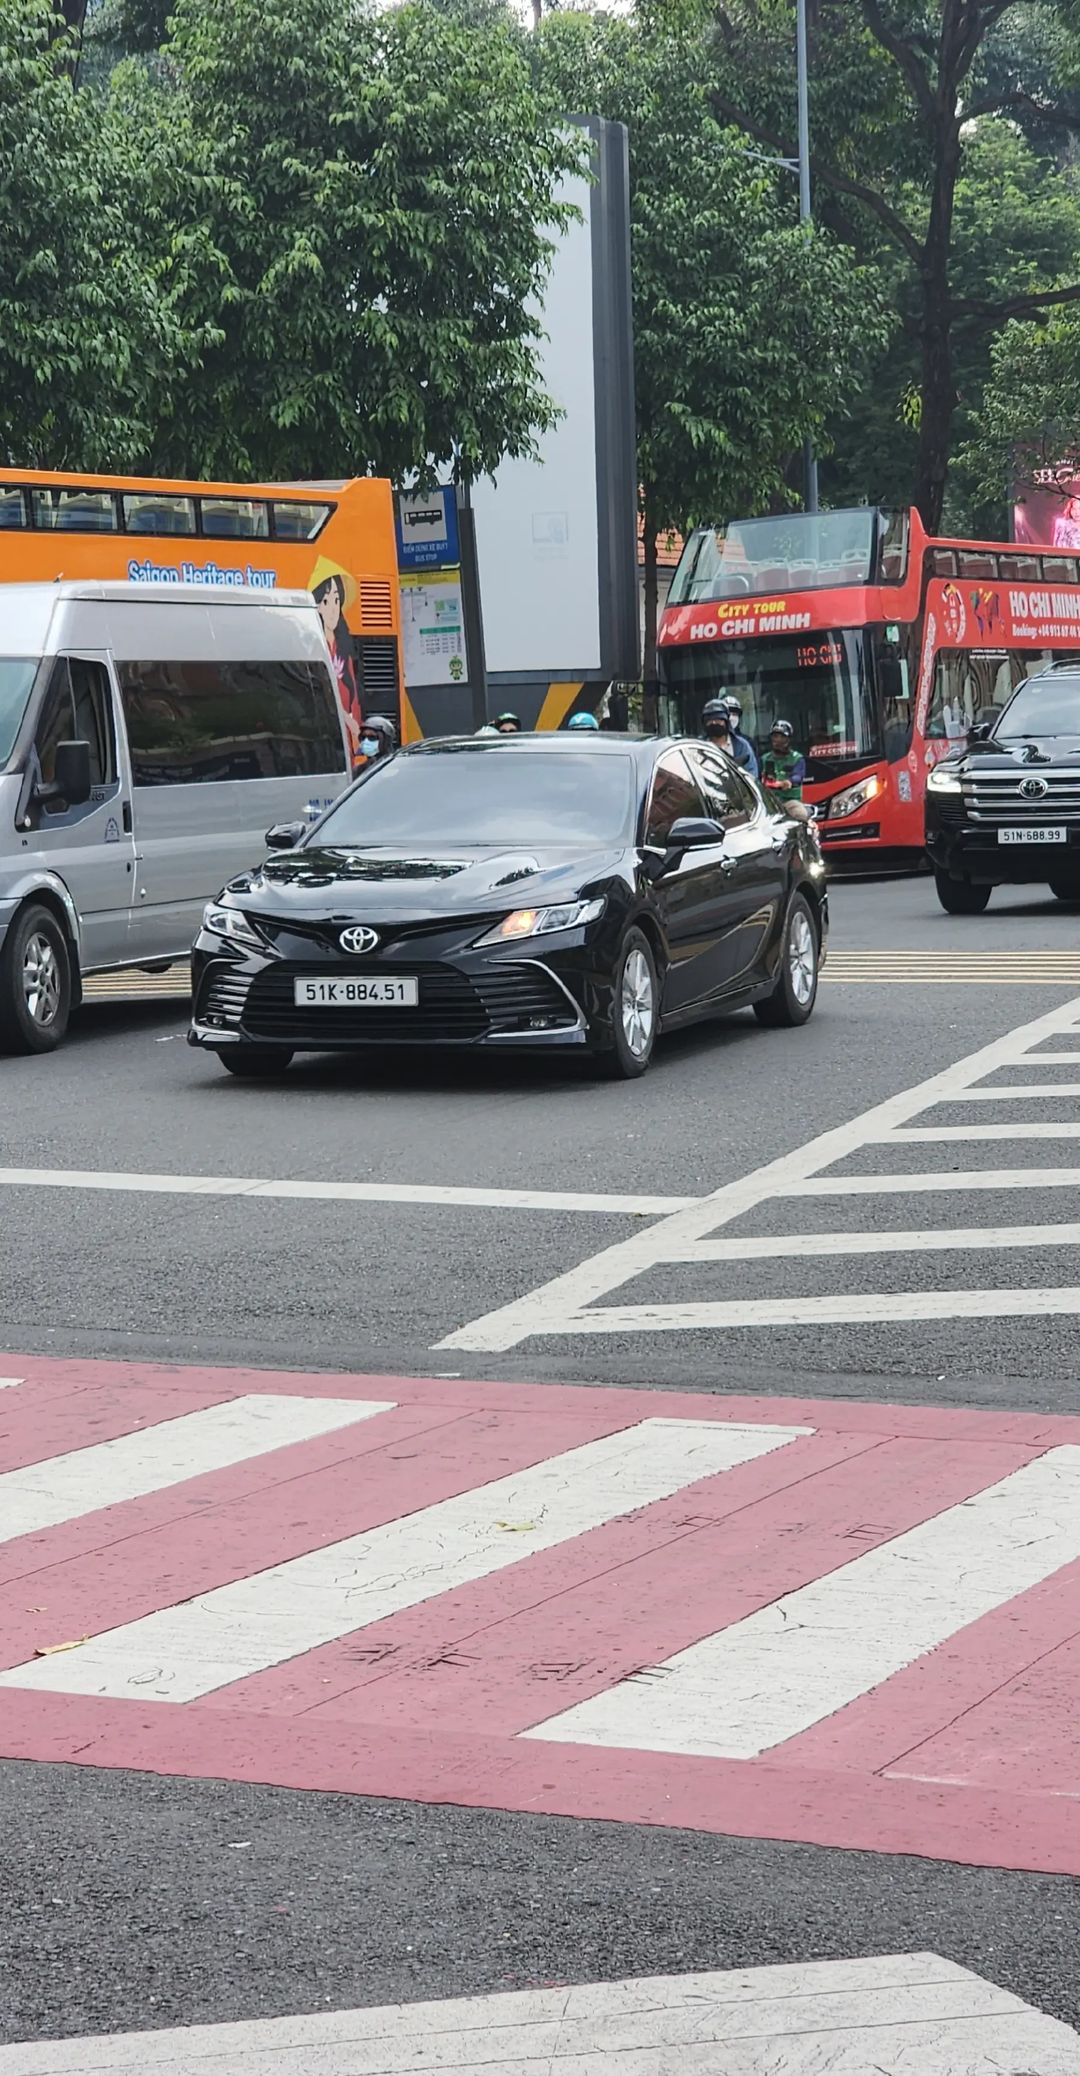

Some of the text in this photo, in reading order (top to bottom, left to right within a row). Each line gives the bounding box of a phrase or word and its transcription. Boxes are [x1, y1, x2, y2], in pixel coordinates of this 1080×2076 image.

[128, 560, 276, 588] Saigon Heritage tour
[1009, 591, 1028, 618] HO
[1029, 591, 1051, 618] CHI
[690, 612, 811, 640] HO CHI MINH
[797, 647, 816, 667] HO
[306, 983, 405, 1001] 51K-884.51
